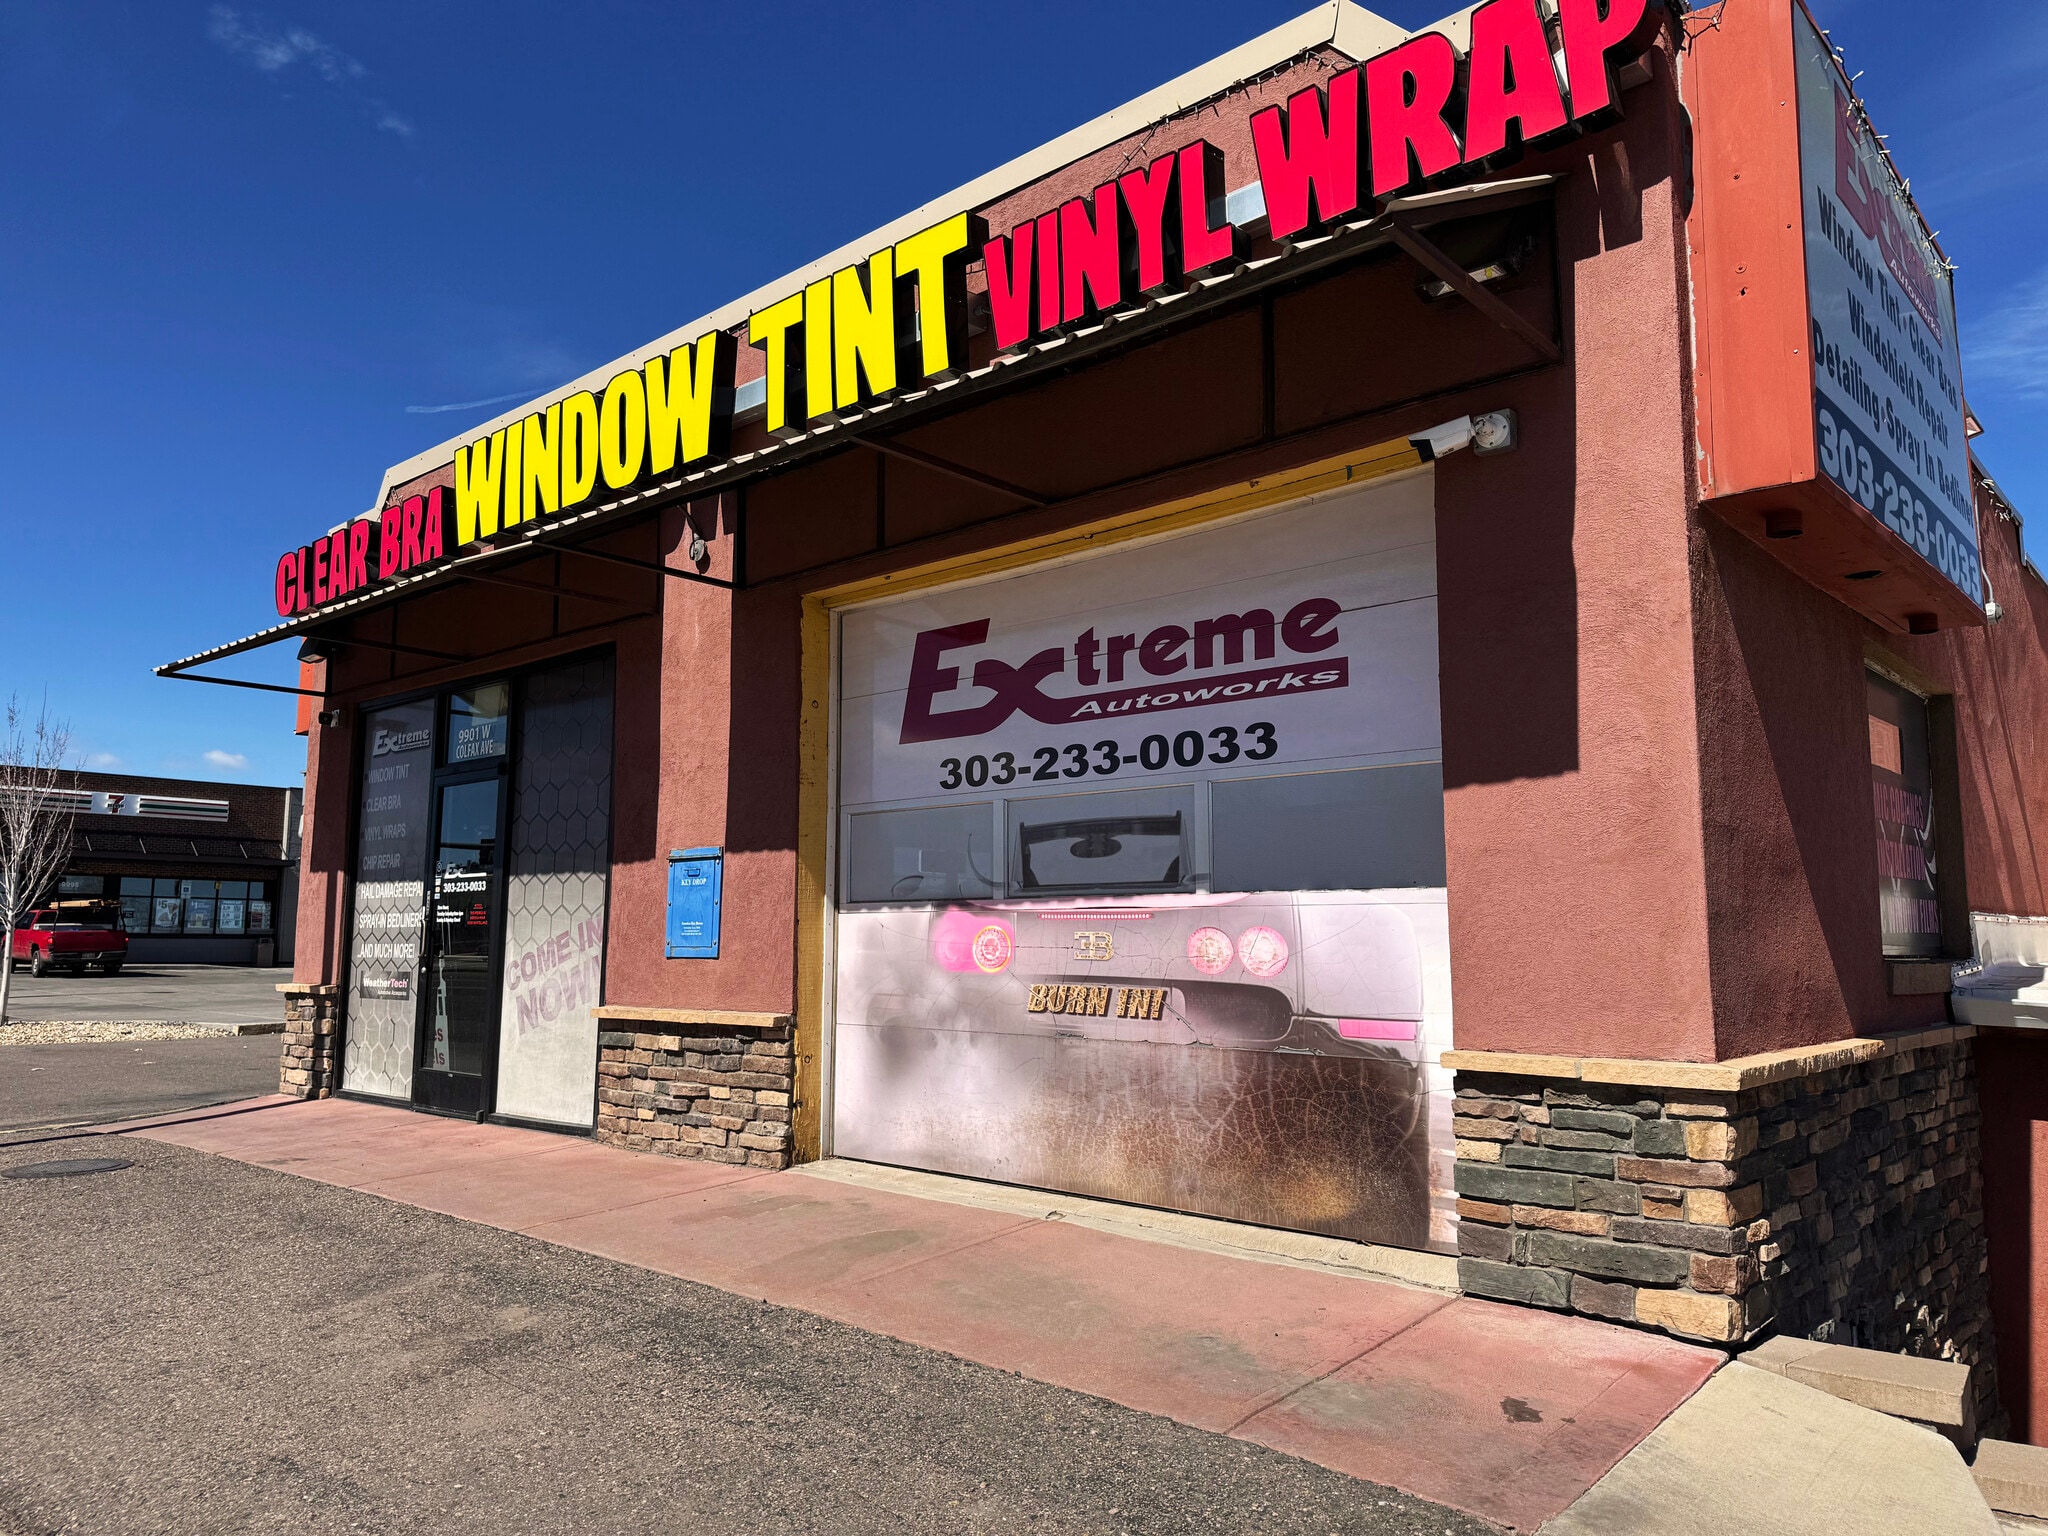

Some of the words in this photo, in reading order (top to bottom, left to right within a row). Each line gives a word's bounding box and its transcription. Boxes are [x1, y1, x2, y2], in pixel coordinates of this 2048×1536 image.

[276, 519, 368, 616] CLEAR
[380, 486, 443, 580] BRA
[454, 331, 718, 546] WINDOW
[749, 211, 968, 433] TINT
[984, 141, 1233, 350] VINYL
[1251, 0, 1647, 240] WRAP
[1817, 186, 1874, 295] Window
[1877, 268, 1902, 333] Tint
[1909, 314, 1936, 378] Clear
[1937, 354, 1958, 412] Bras
[1890, 257, 1943, 343] Autoworks
[1847, 287, 1915, 407] Windshield
[1916, 378, 1949, 450] Repair
[1812, 317, 1880, 433] Detailing
[1885, 395, 1921, 475] Spray
[1923, 439, 1936, 485] In
[1819, 408, 1981, 606] 303-233-0033
[900, 598, 1342, 744] Extreme
[1070, 667, 1340, 718] Autoworks
[373, 729, 430, 756] Extreme
[458, 727, 480, 744] 9901
[481, 724, 492, 739] W
[455, 742, 480, 759] COLFAX
[480, 740, 494, 755] AVE
[939, 721, 1278, 790] 303-233-0033
[368, 766, 394, 784] WINDOW
[395, 764, 411, 780] TINT
[366, 795, 386, 812] CLEAR
[387, 794, 401, 809] BRA
[364, 826, 381, 841] VINYL
[382, 823, 406, 839] WRAPS
[362, 855, 377, 871] CHIP
[378, 853, 400, 869] REPAIR
[361, 883, 375, 899] HAIL
[376, 882, 402, 898] DAMAGE
[443, 880, 487, 893] 303-233-0033
[692, 877, 707, 886] DROP
[359, 912, 386, 928] SPRAY-IN
[374, 943, 393, 958] MUCH
[506, 930, 572, 991] COME
[363, 977, 408, 988] WeatherTech
[1027, 983, 1111, 1016] BURN
[1116, 986, 1166, 1019] IN!
